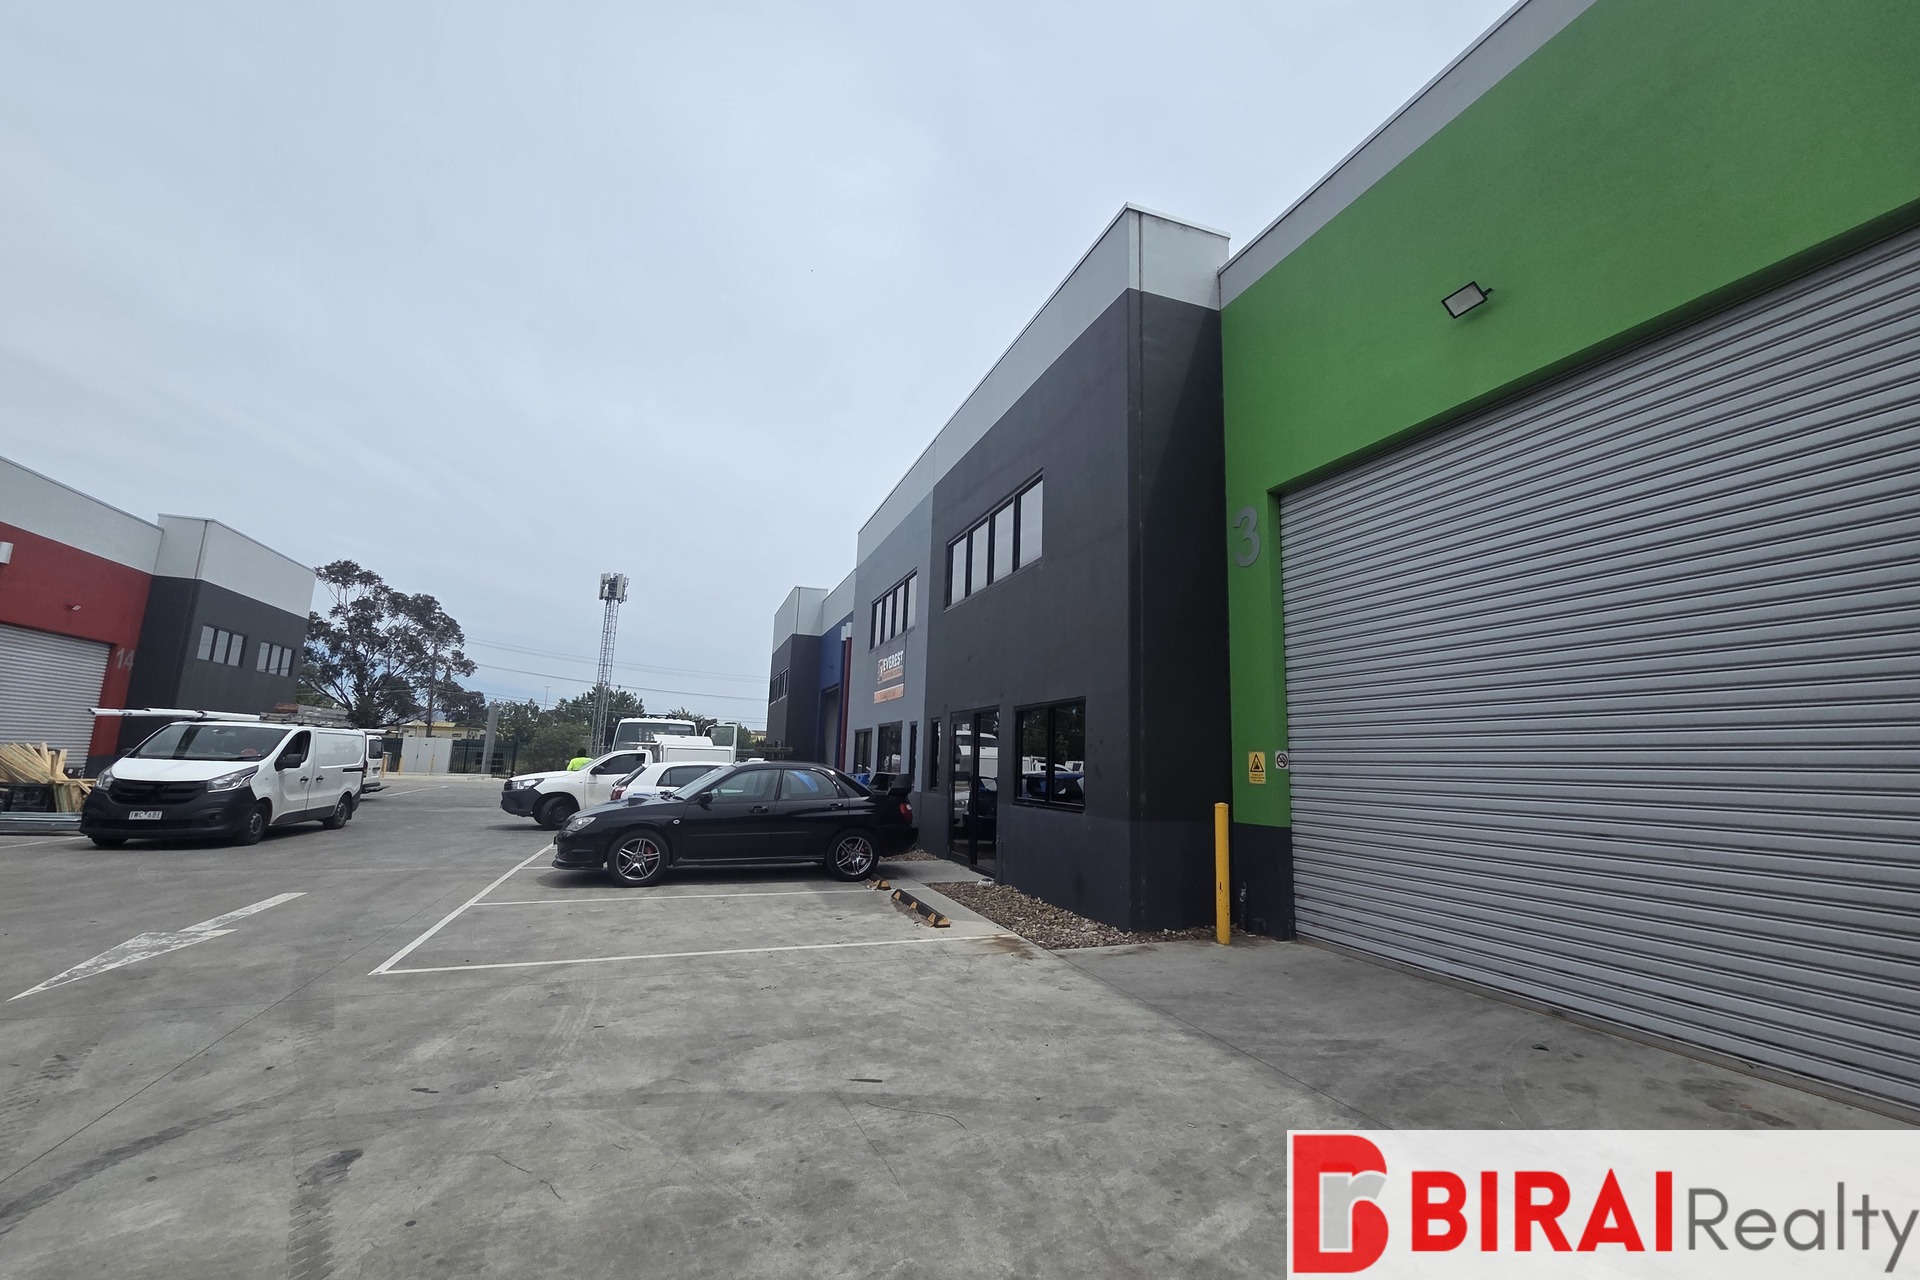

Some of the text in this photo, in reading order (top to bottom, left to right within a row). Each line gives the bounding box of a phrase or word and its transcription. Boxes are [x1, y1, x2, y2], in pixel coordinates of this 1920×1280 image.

[1233, 506, 1261, 568] 3
[116, 647, 135, 670] 14
[883, 650, 904, 672] EVEREST
